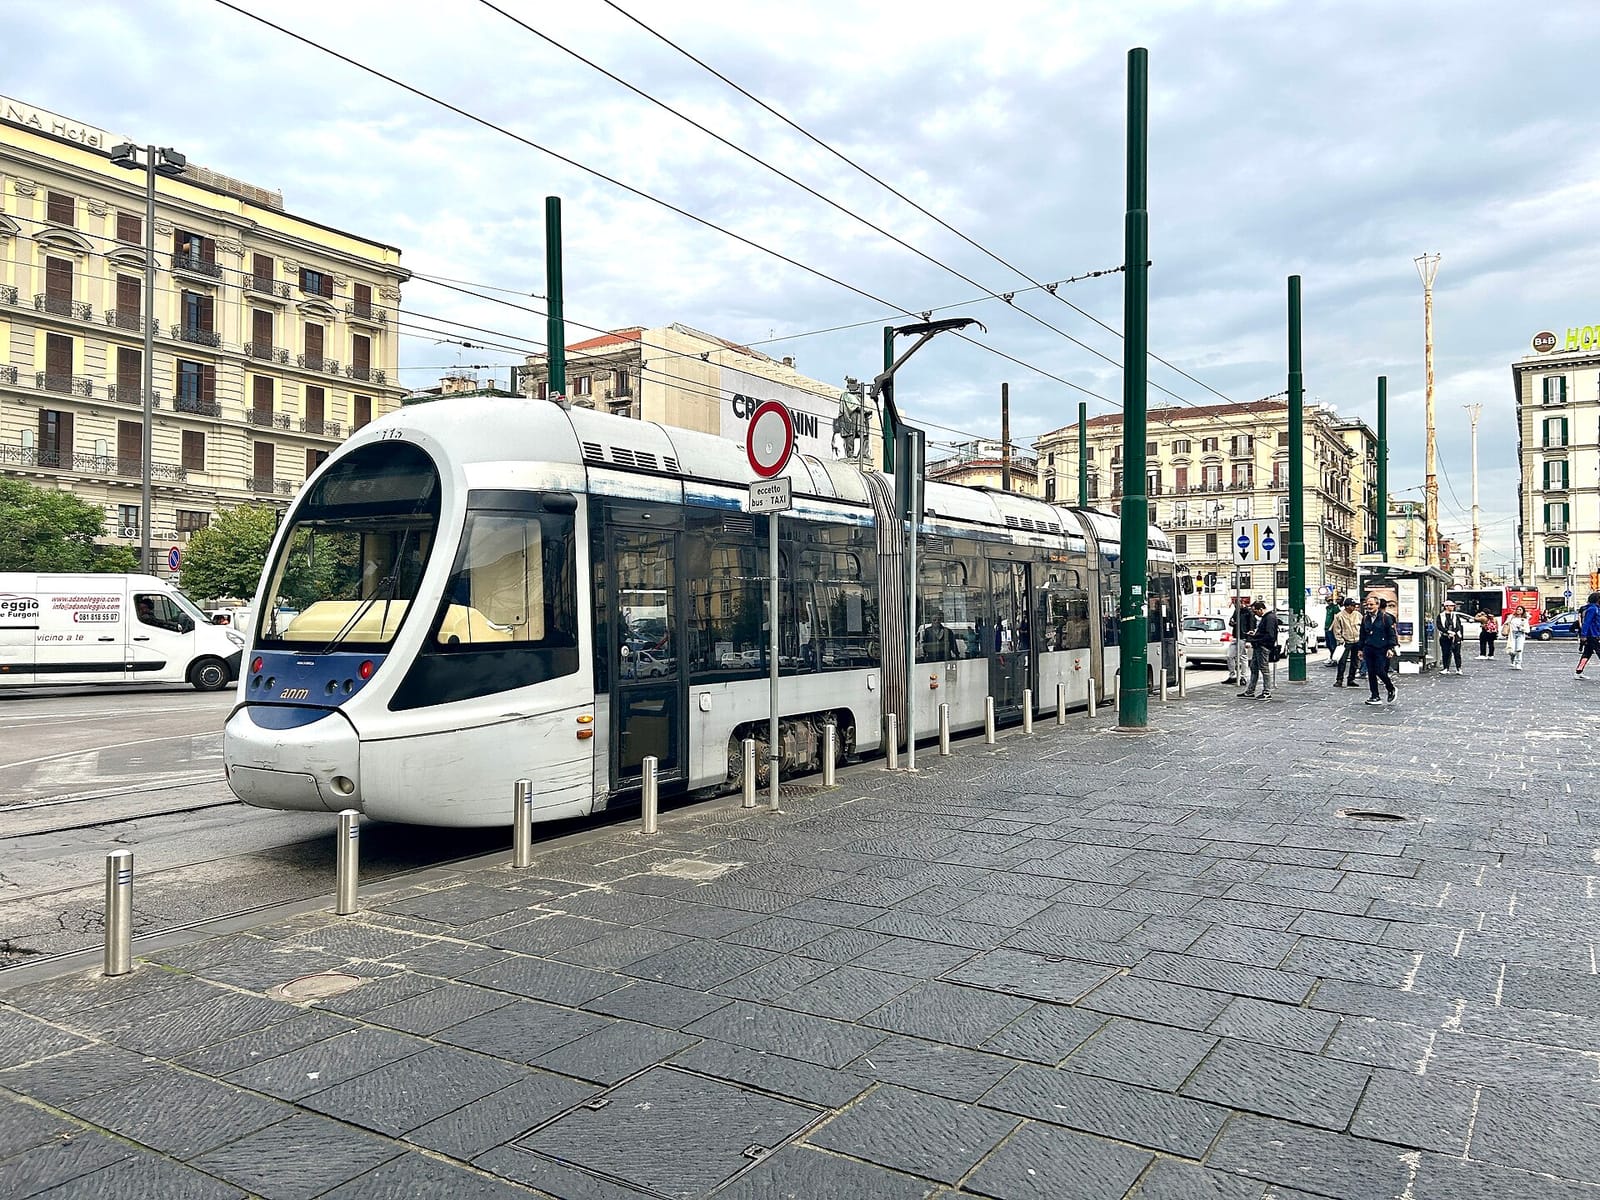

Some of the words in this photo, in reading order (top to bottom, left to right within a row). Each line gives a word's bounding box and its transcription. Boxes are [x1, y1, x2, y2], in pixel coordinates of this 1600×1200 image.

[52, 119, 103, 149] Hotel
[757, 485, 781, 495] eccetto
[751, 498, 763, 507] bus
[771, 495, 786, 504] TAXI
[280, 688, 309, 699] anm
